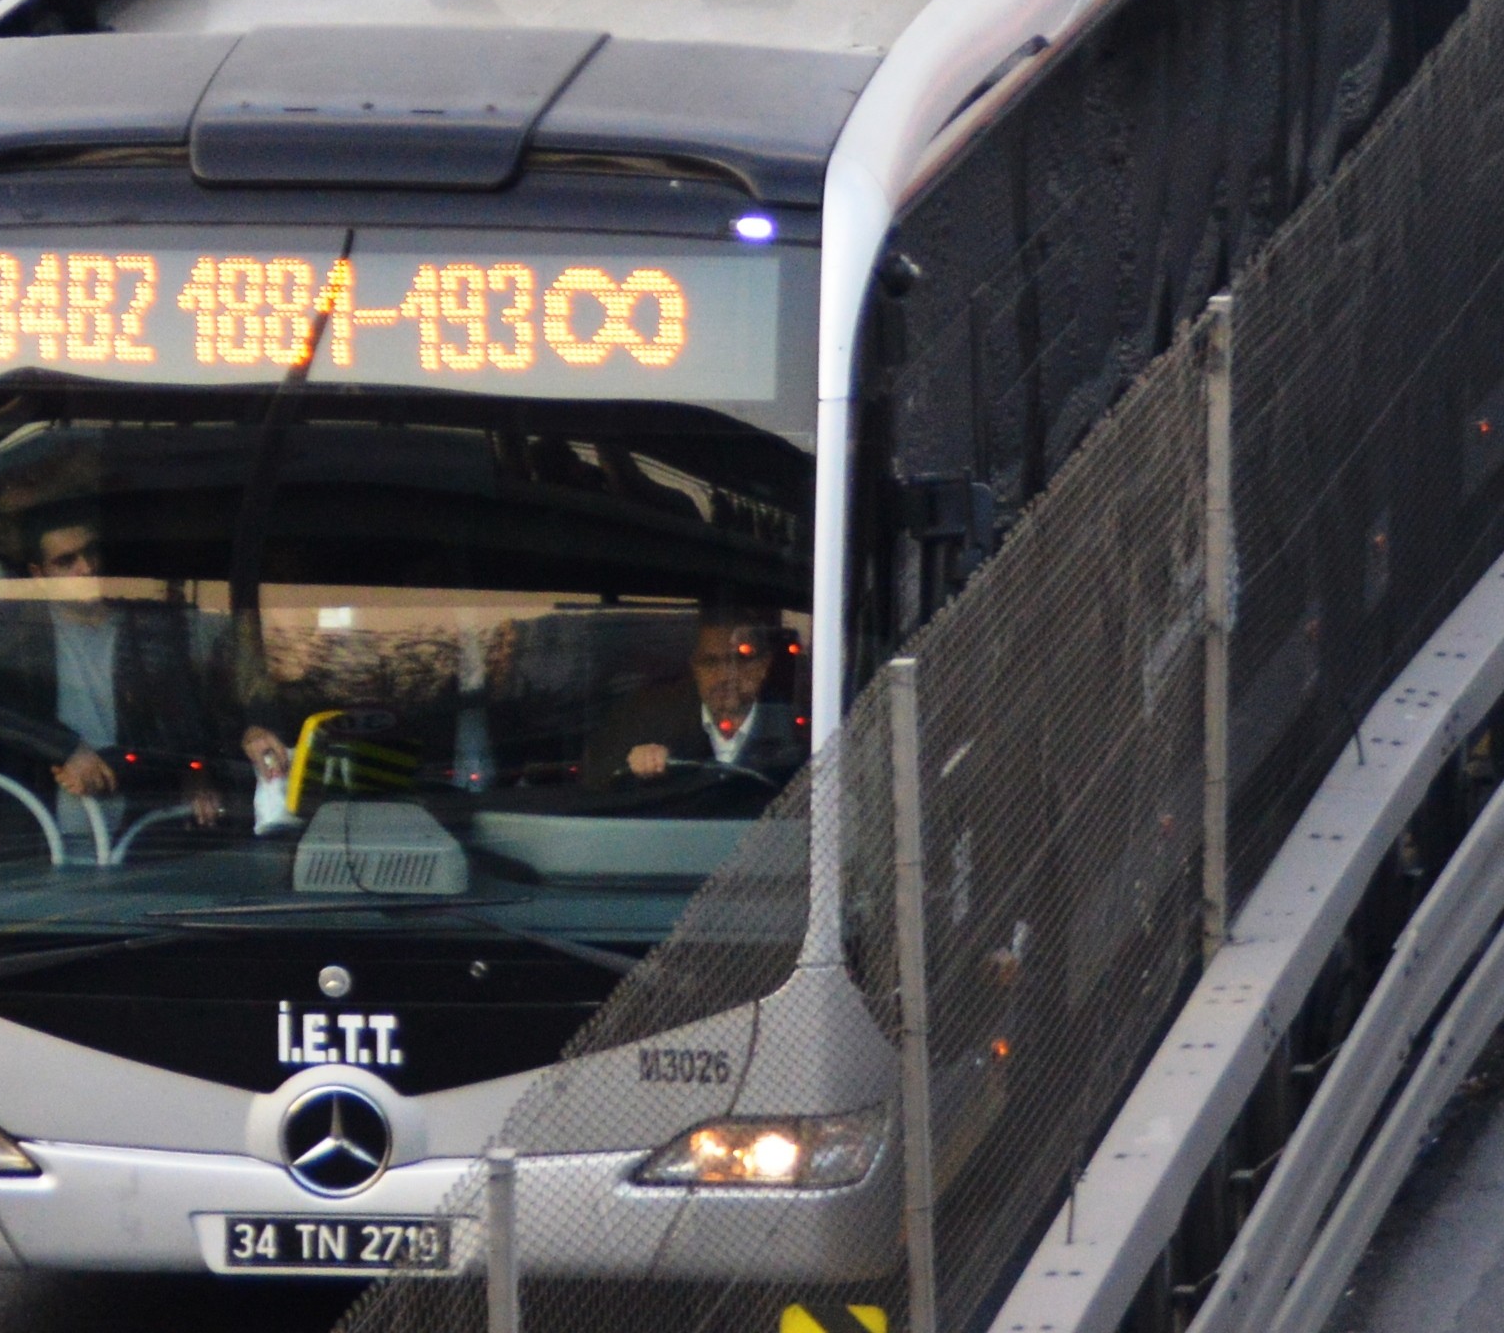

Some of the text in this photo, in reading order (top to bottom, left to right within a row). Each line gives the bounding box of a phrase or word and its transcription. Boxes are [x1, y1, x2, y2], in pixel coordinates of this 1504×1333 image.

[638, 1047, 730, 1085] M3026
[232, 1224, 278, 1261] 34
[299, 1224, 347, 1261] TN
